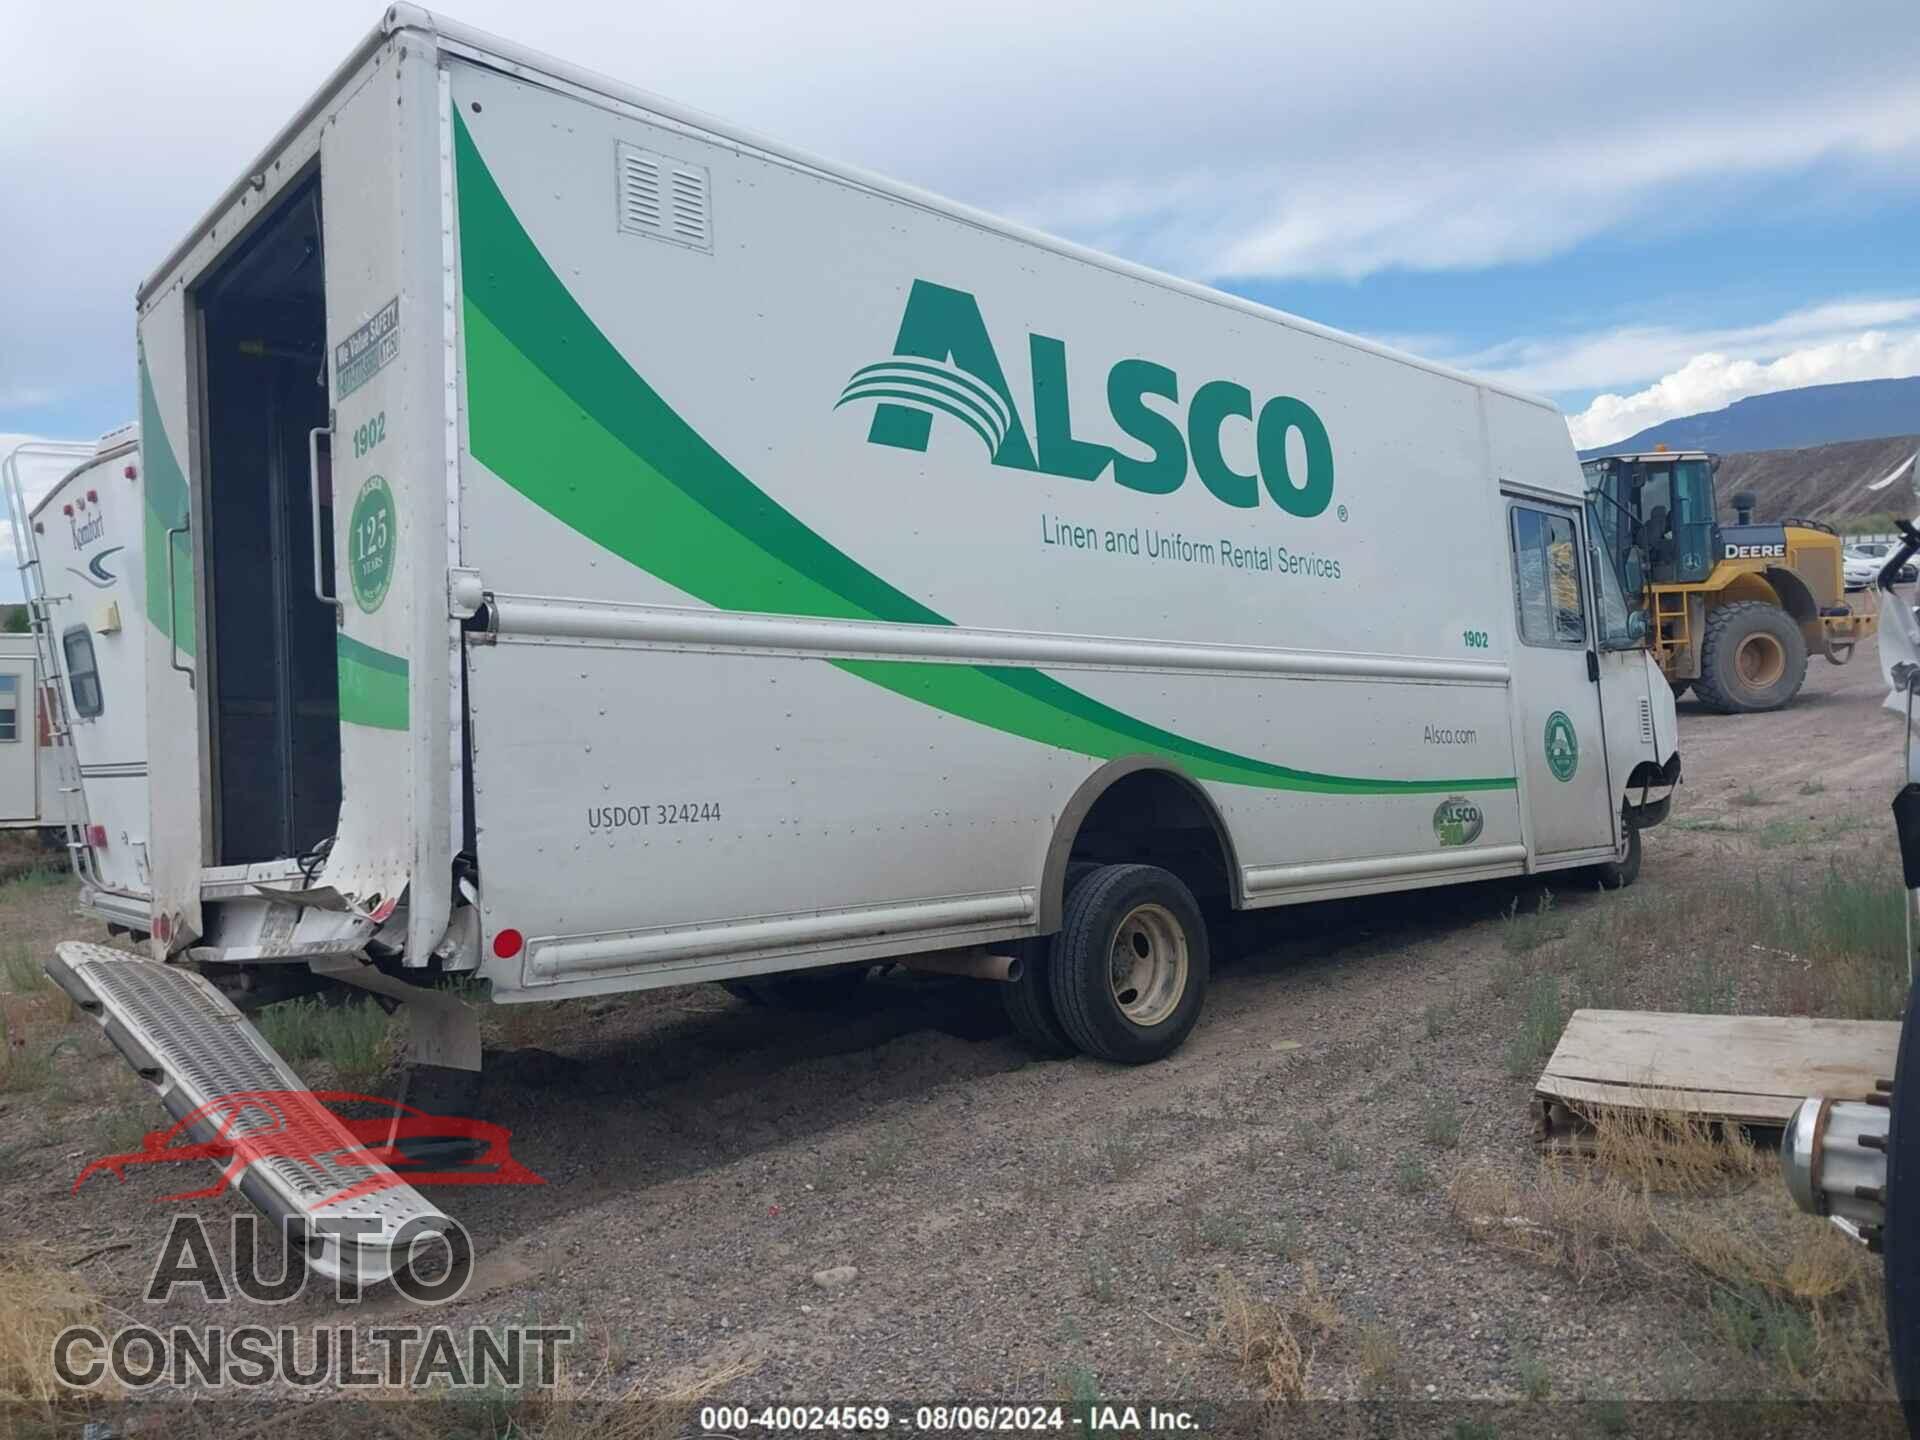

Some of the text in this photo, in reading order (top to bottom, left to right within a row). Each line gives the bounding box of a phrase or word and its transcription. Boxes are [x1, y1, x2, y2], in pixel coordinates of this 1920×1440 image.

[834, 278, 1335, 518] ALSCO
[353, 411, 386, 459] 1902
[357, 509, 387, 561] 125
[1042, 513, 1341, 579] Linen and Uniform Rental Services
[1725, 544, 1785, 559] DEERE
[1463, 630, 1489, 648] 1902
[1423, 725, 1477, 745] Alsco.com
[588, 803, 721, 828] USDOT 324244
[1440, 807, 1478, 824] ALSCO
